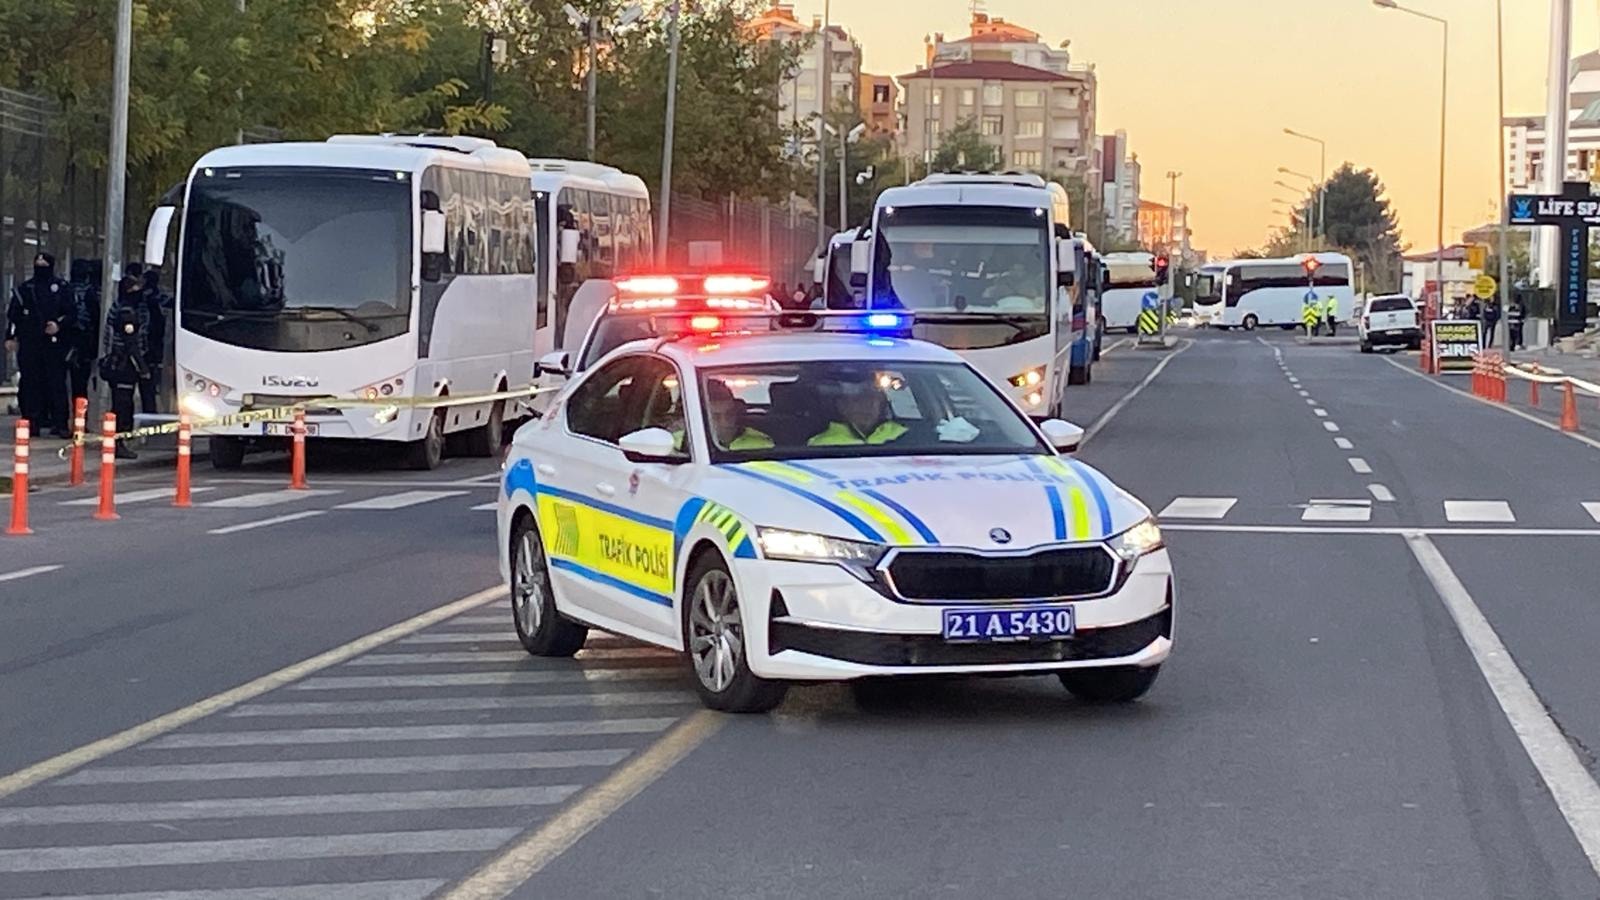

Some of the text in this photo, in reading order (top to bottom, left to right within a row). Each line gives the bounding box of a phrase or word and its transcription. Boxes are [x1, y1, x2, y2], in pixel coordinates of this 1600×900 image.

[1538, 197, 1575, 216] LİFE
[262, 375, 319, 387] ISUZU
[599, 533, 668, 578] TRAFİK POLİSİ
[949, 611, 1070, 636] 21 A 5430
